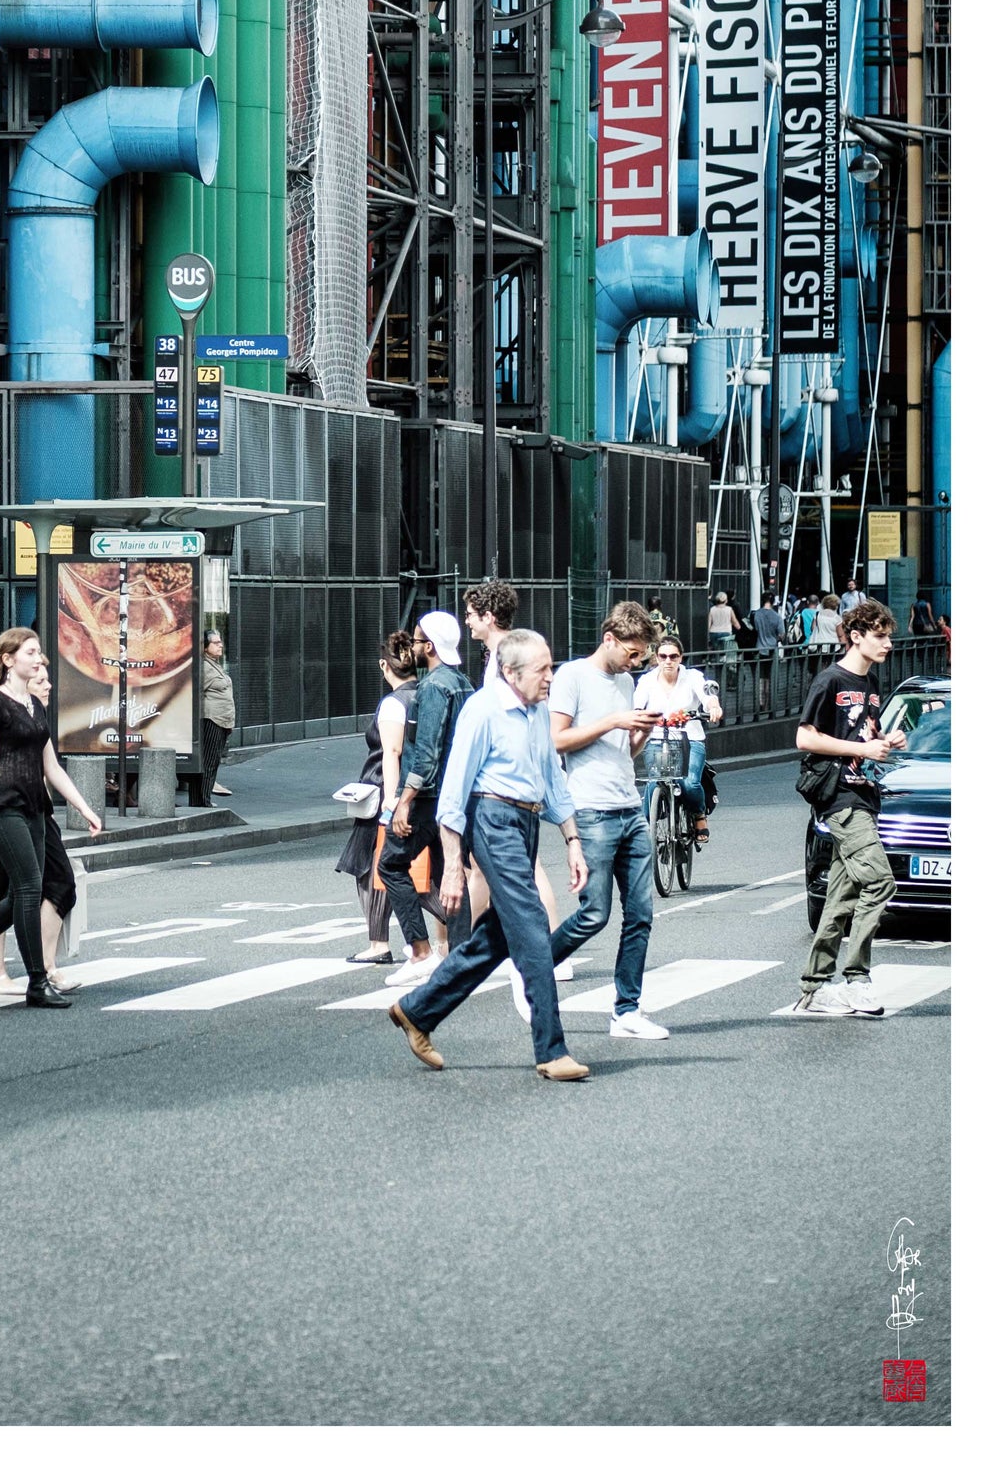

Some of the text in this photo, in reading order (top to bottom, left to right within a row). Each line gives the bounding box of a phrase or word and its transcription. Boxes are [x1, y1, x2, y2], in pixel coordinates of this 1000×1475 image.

[825, 34, 837, 49] ET
[784, 44, 823, 94] DU
[824, 52, 837, 95] DANIEL
[603, 41, 662, 240] TEVEN
[784, 107, 823, 185] ANS
[824, 98, 837, 193] CONTEMPORAIN
[783, 194, 821, 258] DIX
[823, 235, 836, 301] FONDATION
[171, 267, 206, 286] BUS
[783, 270, 821, 340] LES
[823, 303, 835, 320] LA
[823, 323, 835, 339] DE
[159, 338, 176, 351] 38
[229, 339, 255, 347] Centre
[206, 347, 279, 357] Georges Pompidou
[159, 369, 175, 380] 47
[200, 369, 217, 380] 75
[120, 541, 146, 550] Mairie
[148, 541, 159, 549] du
[103, 658, 154, 668] MATINI
[107, 734, 142, 743] MATINI
